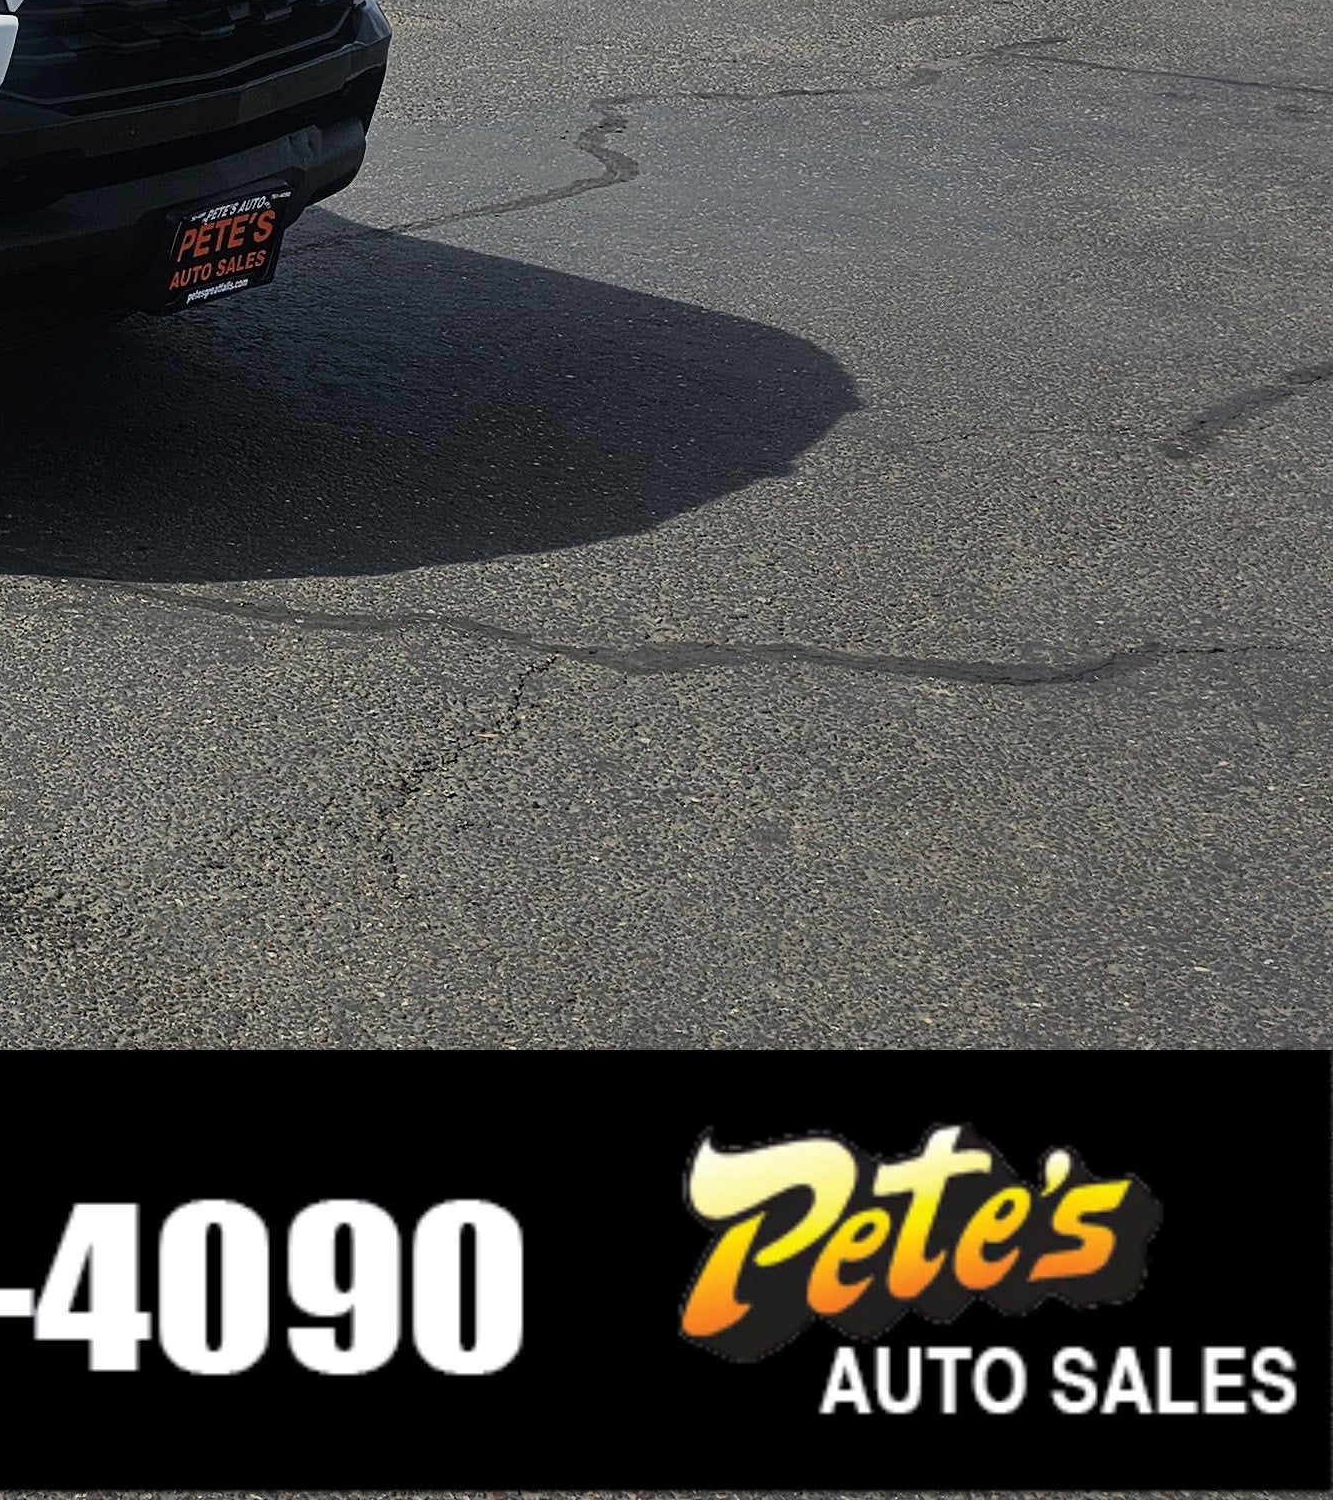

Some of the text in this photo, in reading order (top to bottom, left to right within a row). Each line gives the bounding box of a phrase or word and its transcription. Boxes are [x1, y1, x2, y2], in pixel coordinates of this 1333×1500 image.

[237, 196, 267, 213] AUTO
[176, 210, 276, 263] PETE'S
[169, 249, 267, 290] AUTO SALES
